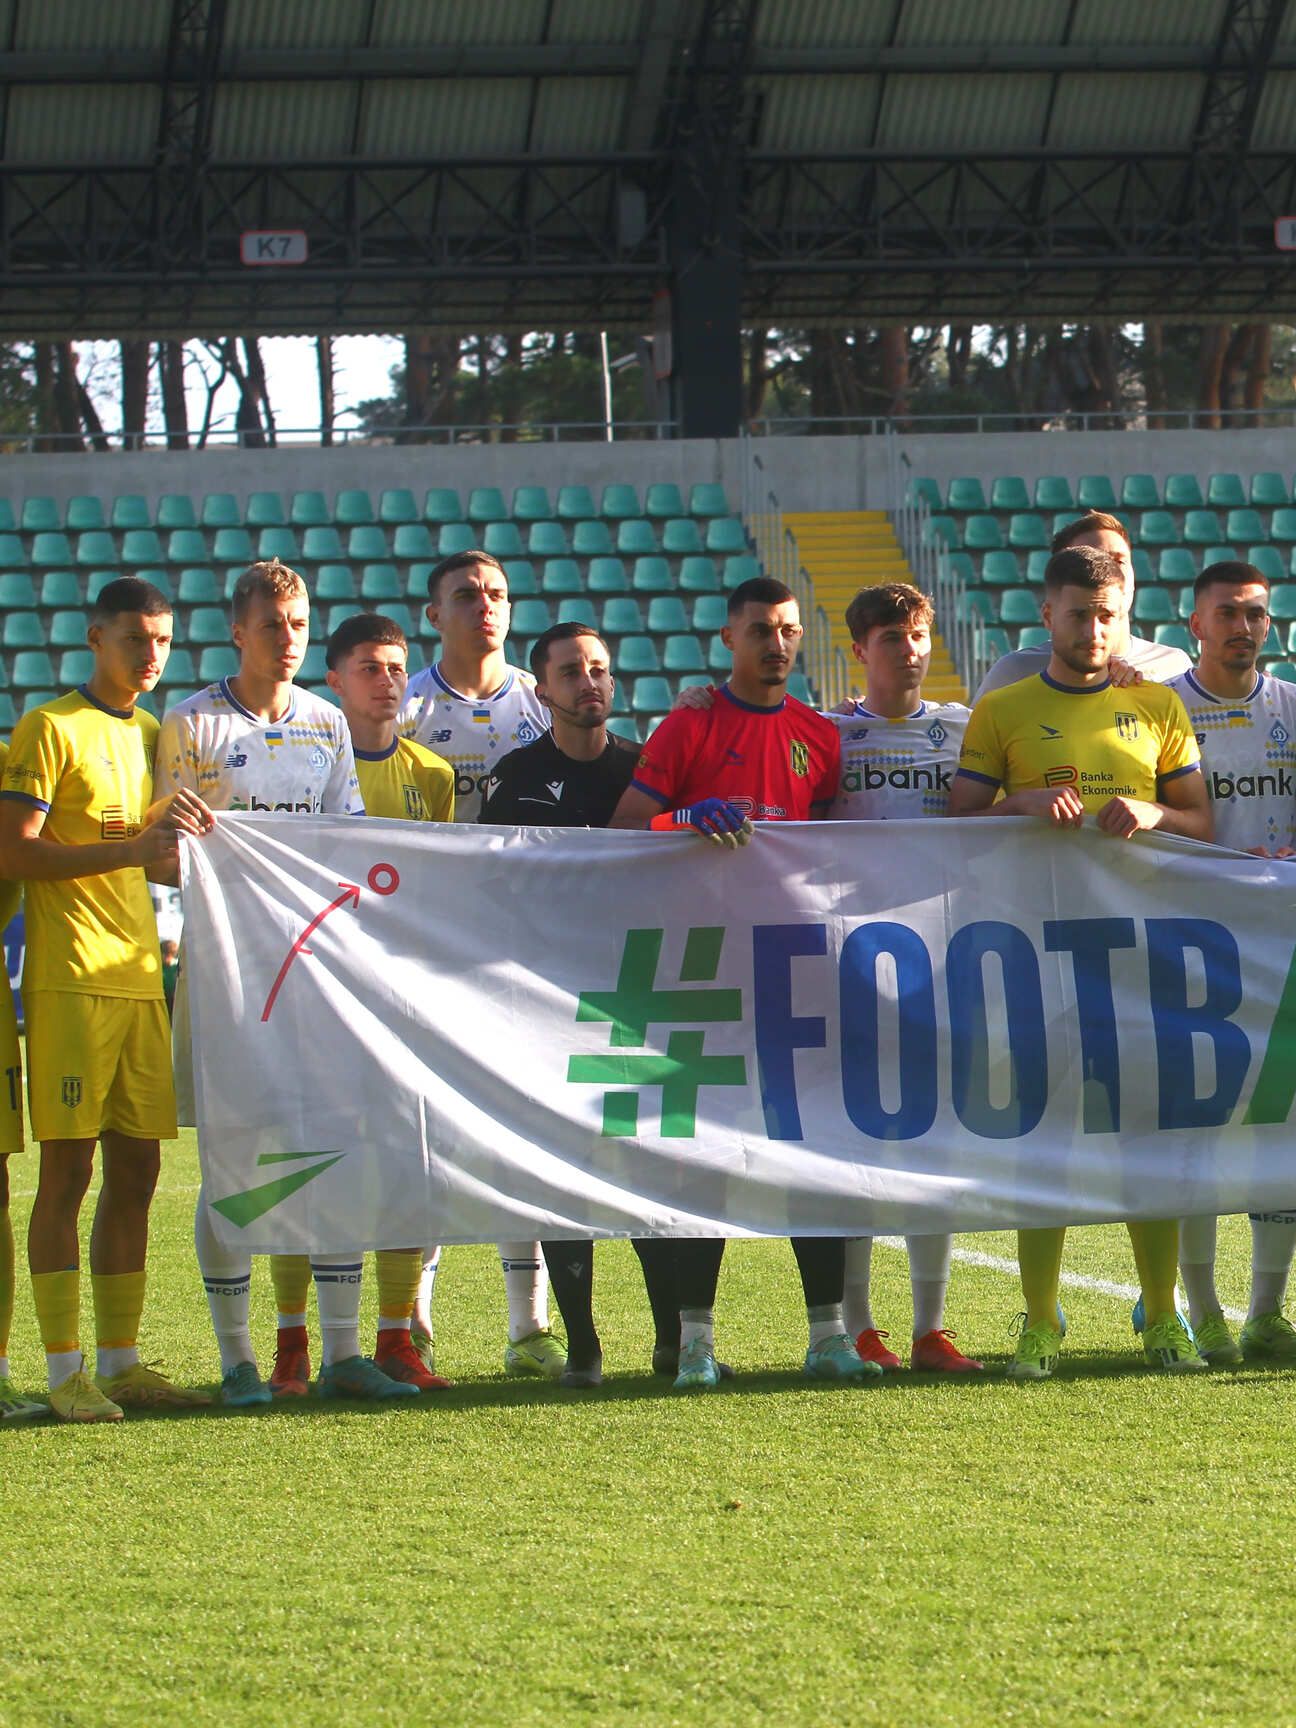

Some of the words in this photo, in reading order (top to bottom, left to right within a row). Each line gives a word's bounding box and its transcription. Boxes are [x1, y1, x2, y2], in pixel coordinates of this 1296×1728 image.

[257, 237, 291, 257] K7
[1081, 771, 1113, 781] Banka
[1207, 767, 1293, 799] bank
[1082, 784, 1137, 796] Ekonomike
[6, 1067, 22, 1111] 1
